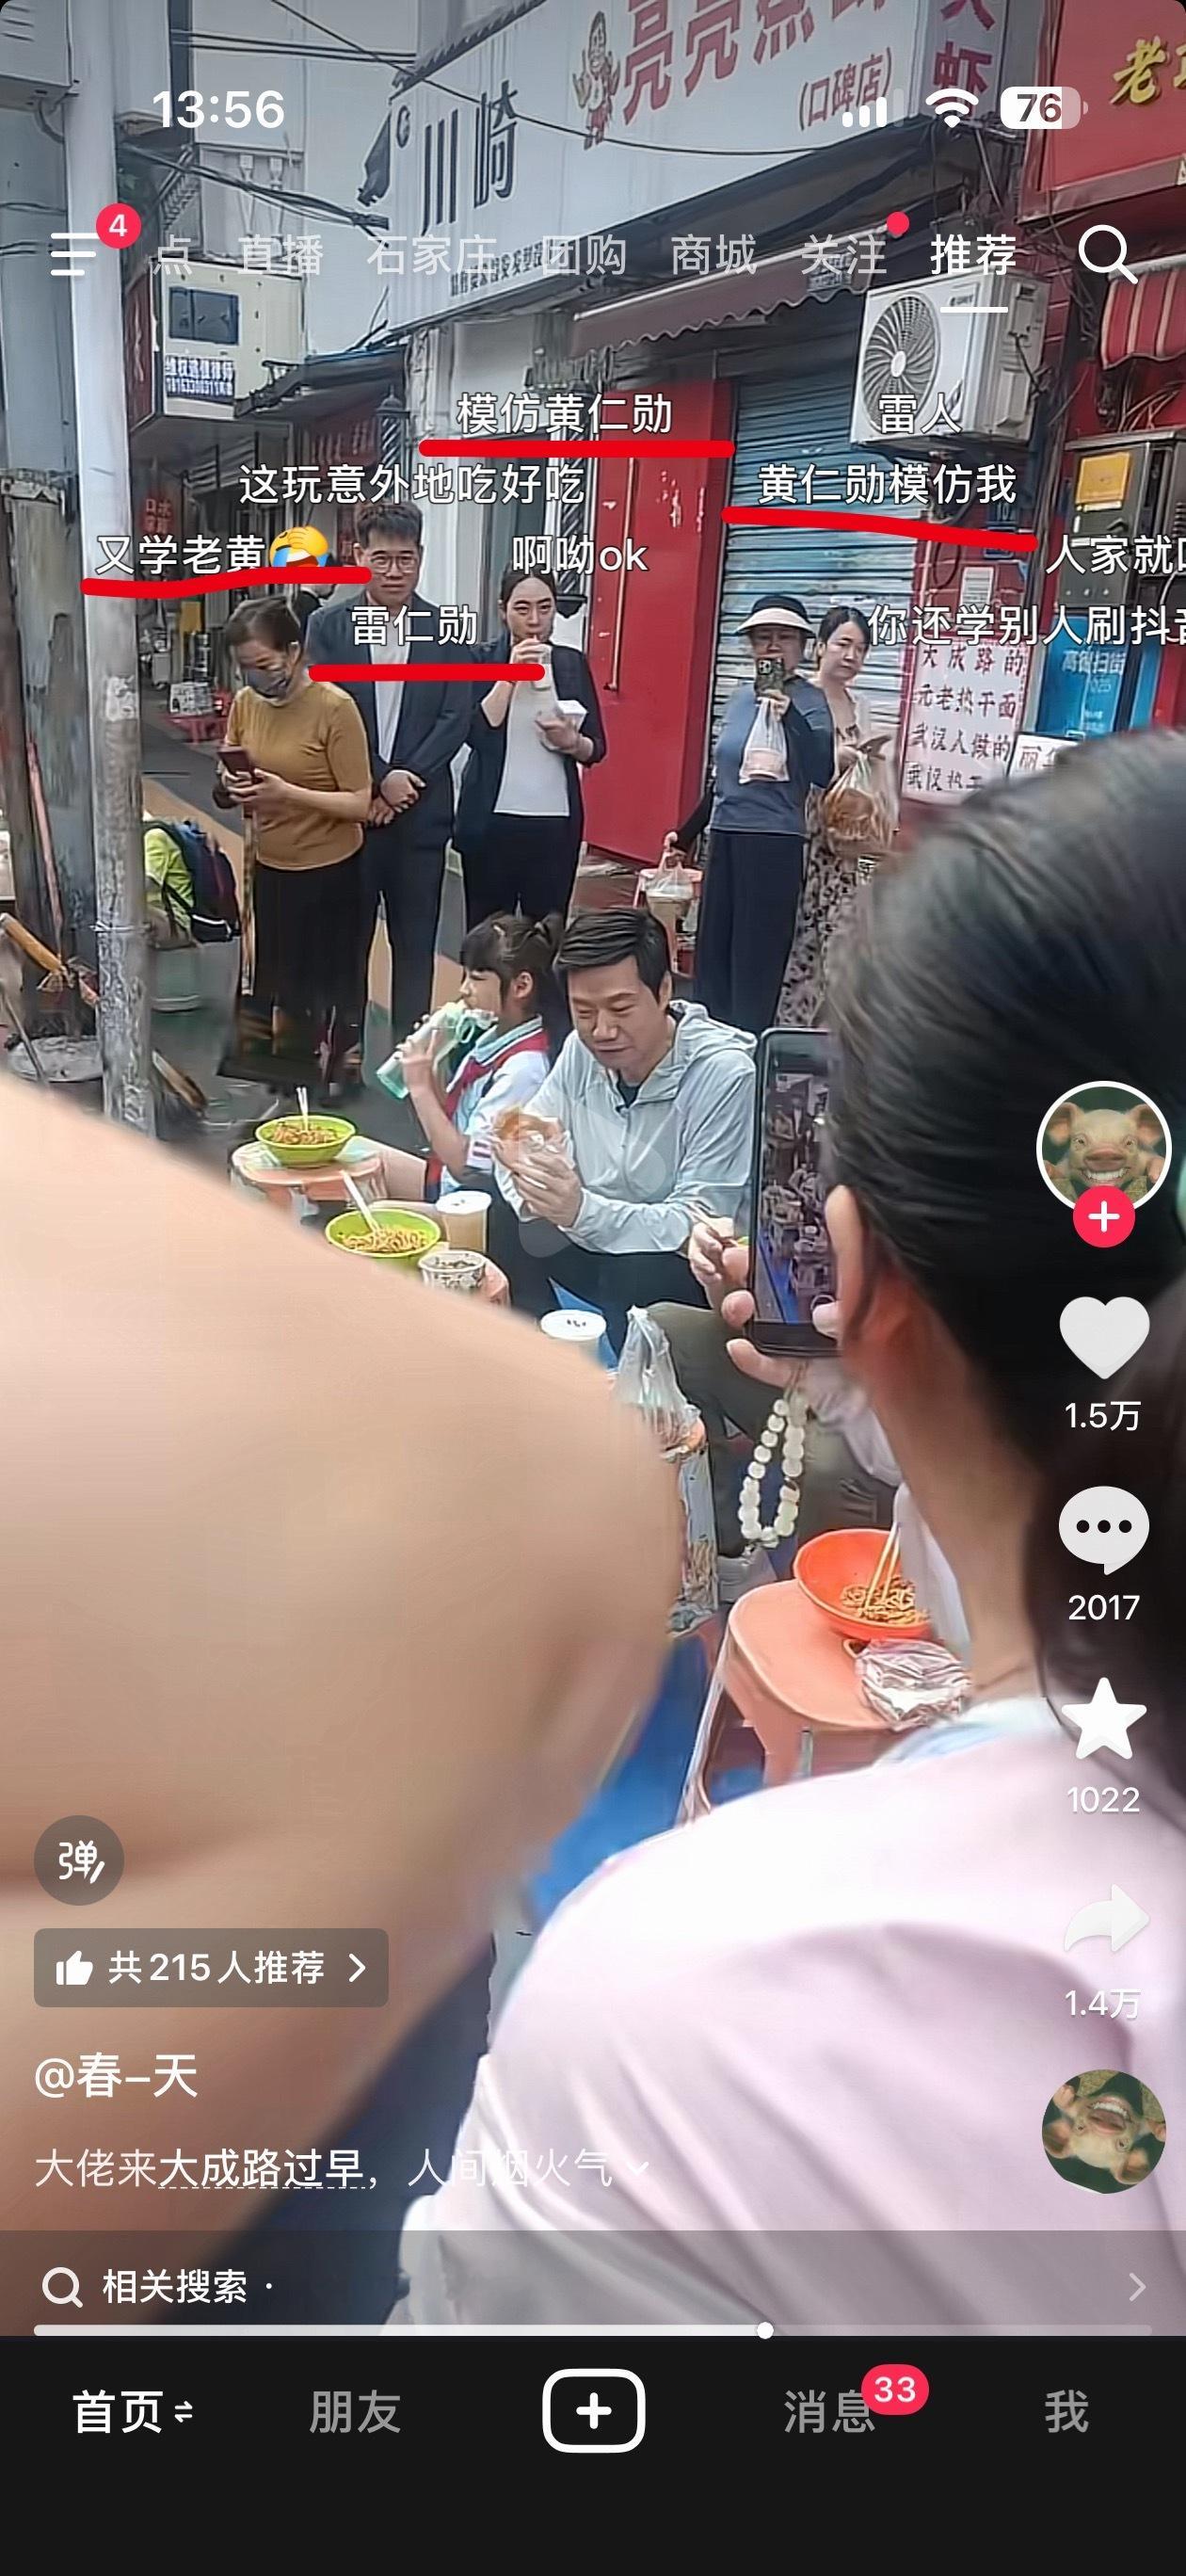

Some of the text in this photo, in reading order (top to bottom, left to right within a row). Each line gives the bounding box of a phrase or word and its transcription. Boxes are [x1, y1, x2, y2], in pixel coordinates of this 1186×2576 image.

[1109, 36, 1186, 105] 老
[421, 80, 519, 236] 川崎
[921, 645, 1024, 677] 大成路的
[913, 684, 1018, 718] 元老热干面
[909, 721, 1012, 762] 武汉人做的
